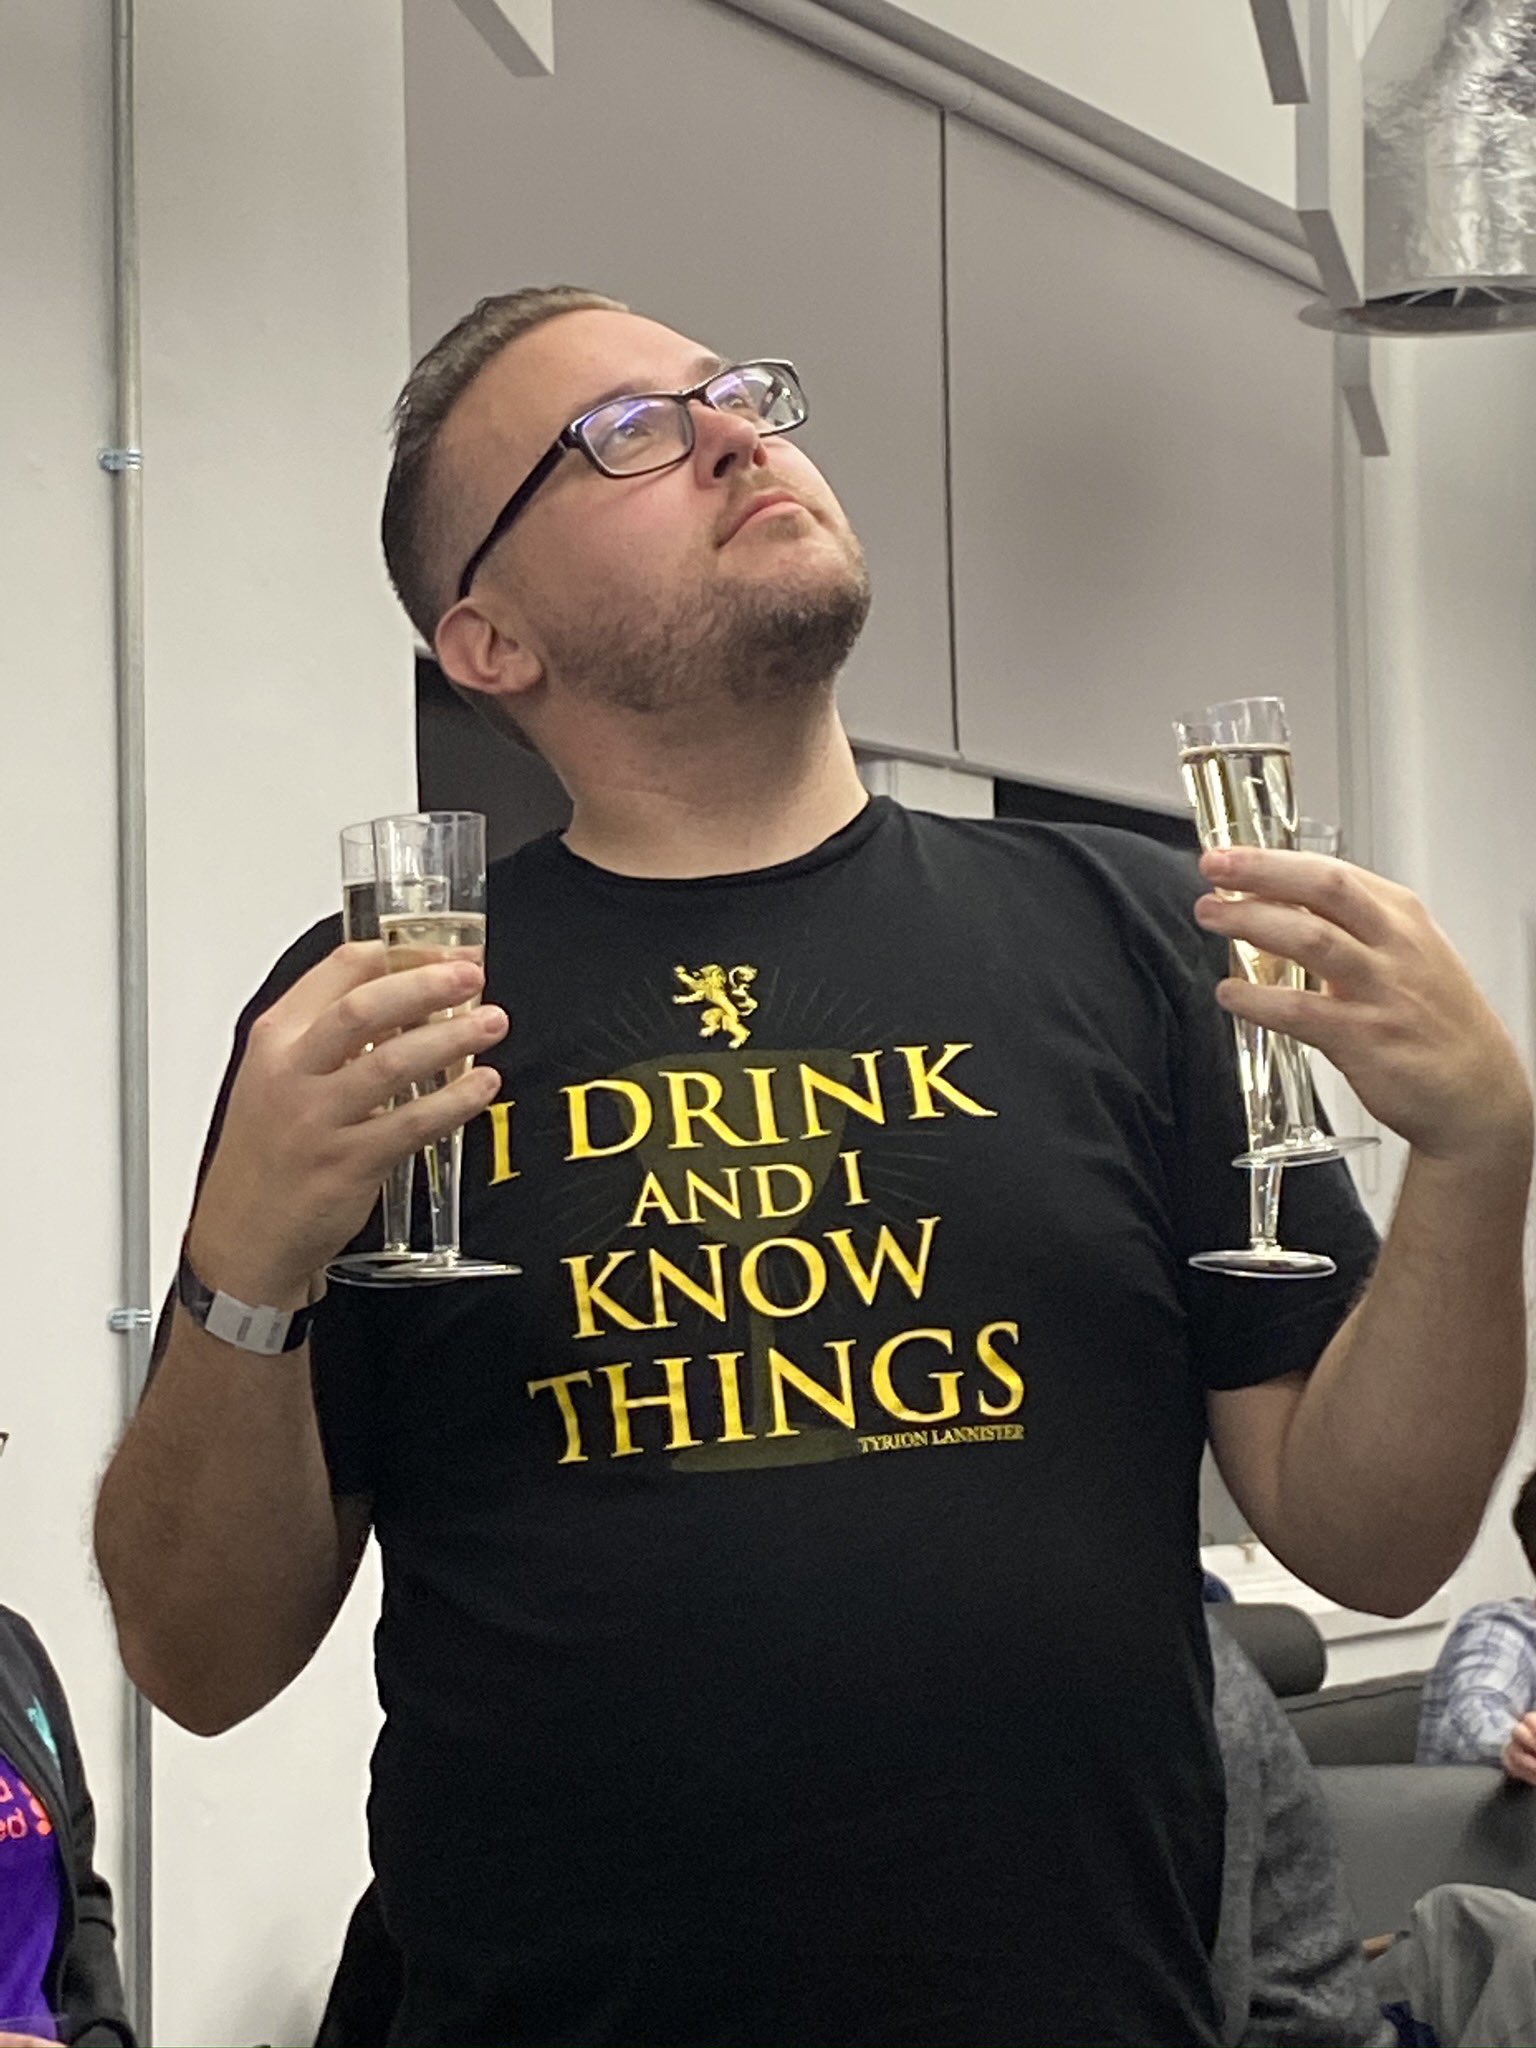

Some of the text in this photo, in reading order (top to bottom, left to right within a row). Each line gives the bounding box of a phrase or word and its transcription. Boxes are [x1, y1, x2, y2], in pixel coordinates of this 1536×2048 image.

[485, 1042, 998, 1186] I DRINK
[626, 1149, 870, 1228] AND I
[559, 1215, 941, 1339] KNOW
[527, 1320, 1026, 1465] THINGS
[857, 1423, 1025, 1453] TYRION LANNISTER
